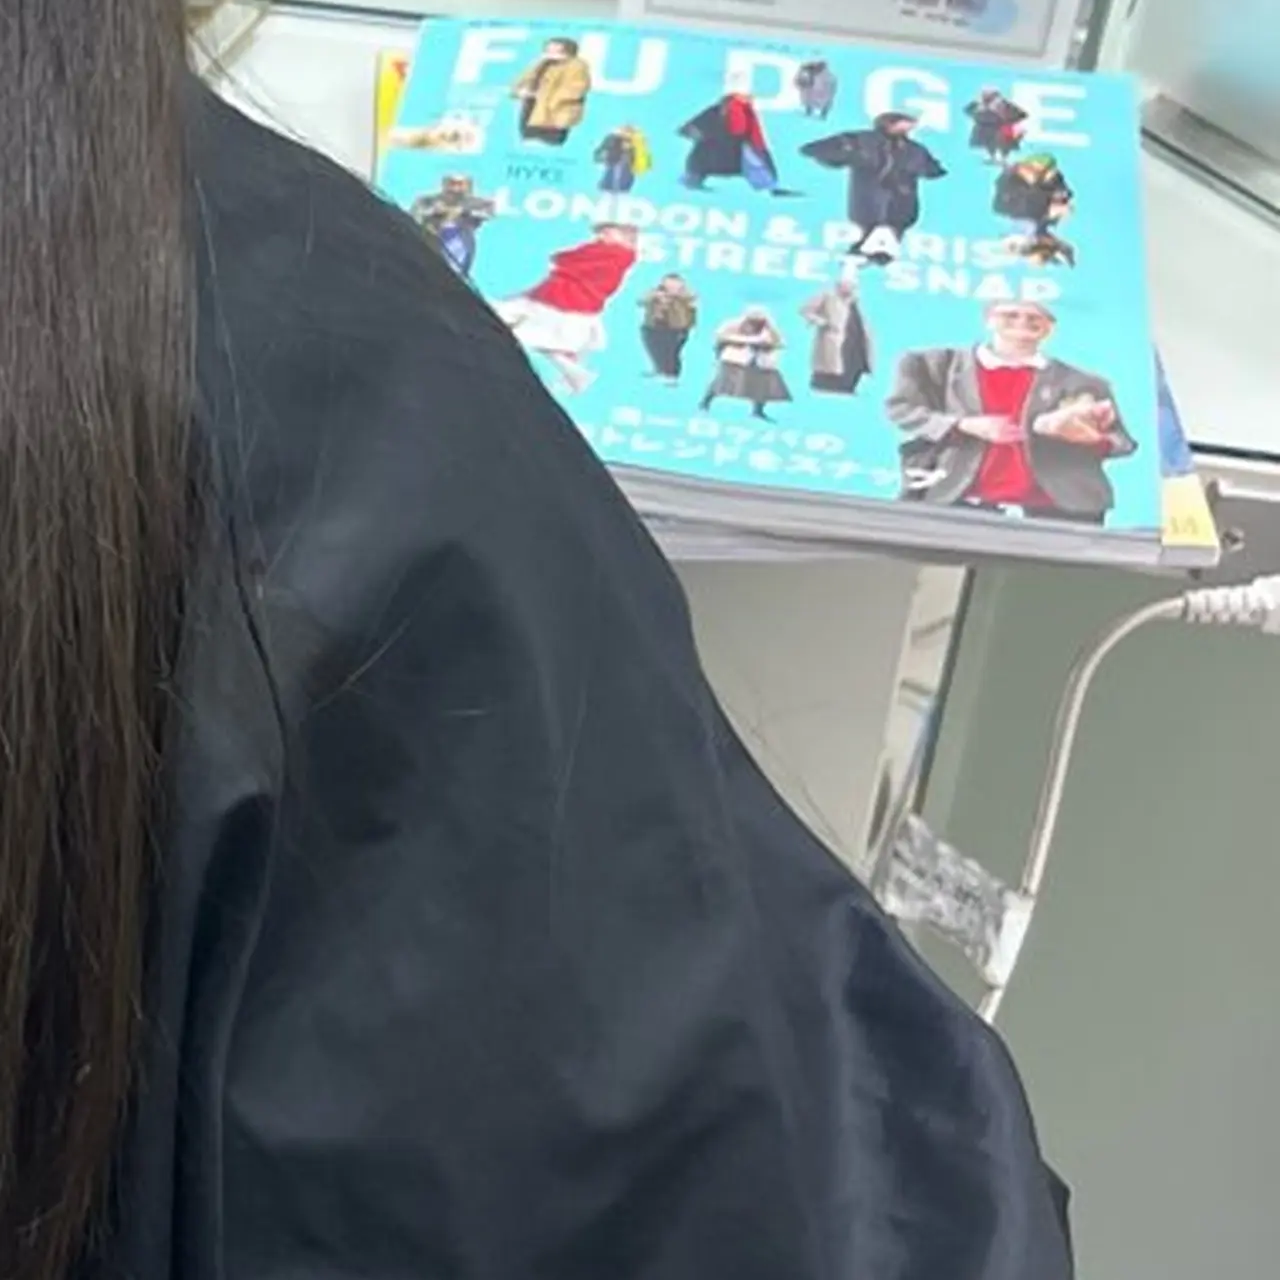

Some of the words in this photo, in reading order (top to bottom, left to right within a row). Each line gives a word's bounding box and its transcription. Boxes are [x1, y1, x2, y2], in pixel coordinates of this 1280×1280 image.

[452, 26, 1091, 148] FUDGE
[493, 185, 748, 240] LONDON
[761, 214, 810, 248] &
[822, 222, 1024, 270] PARIS
[636, 231, 864, 284] STREET
[883, 261, 1064, 304] SNAP
